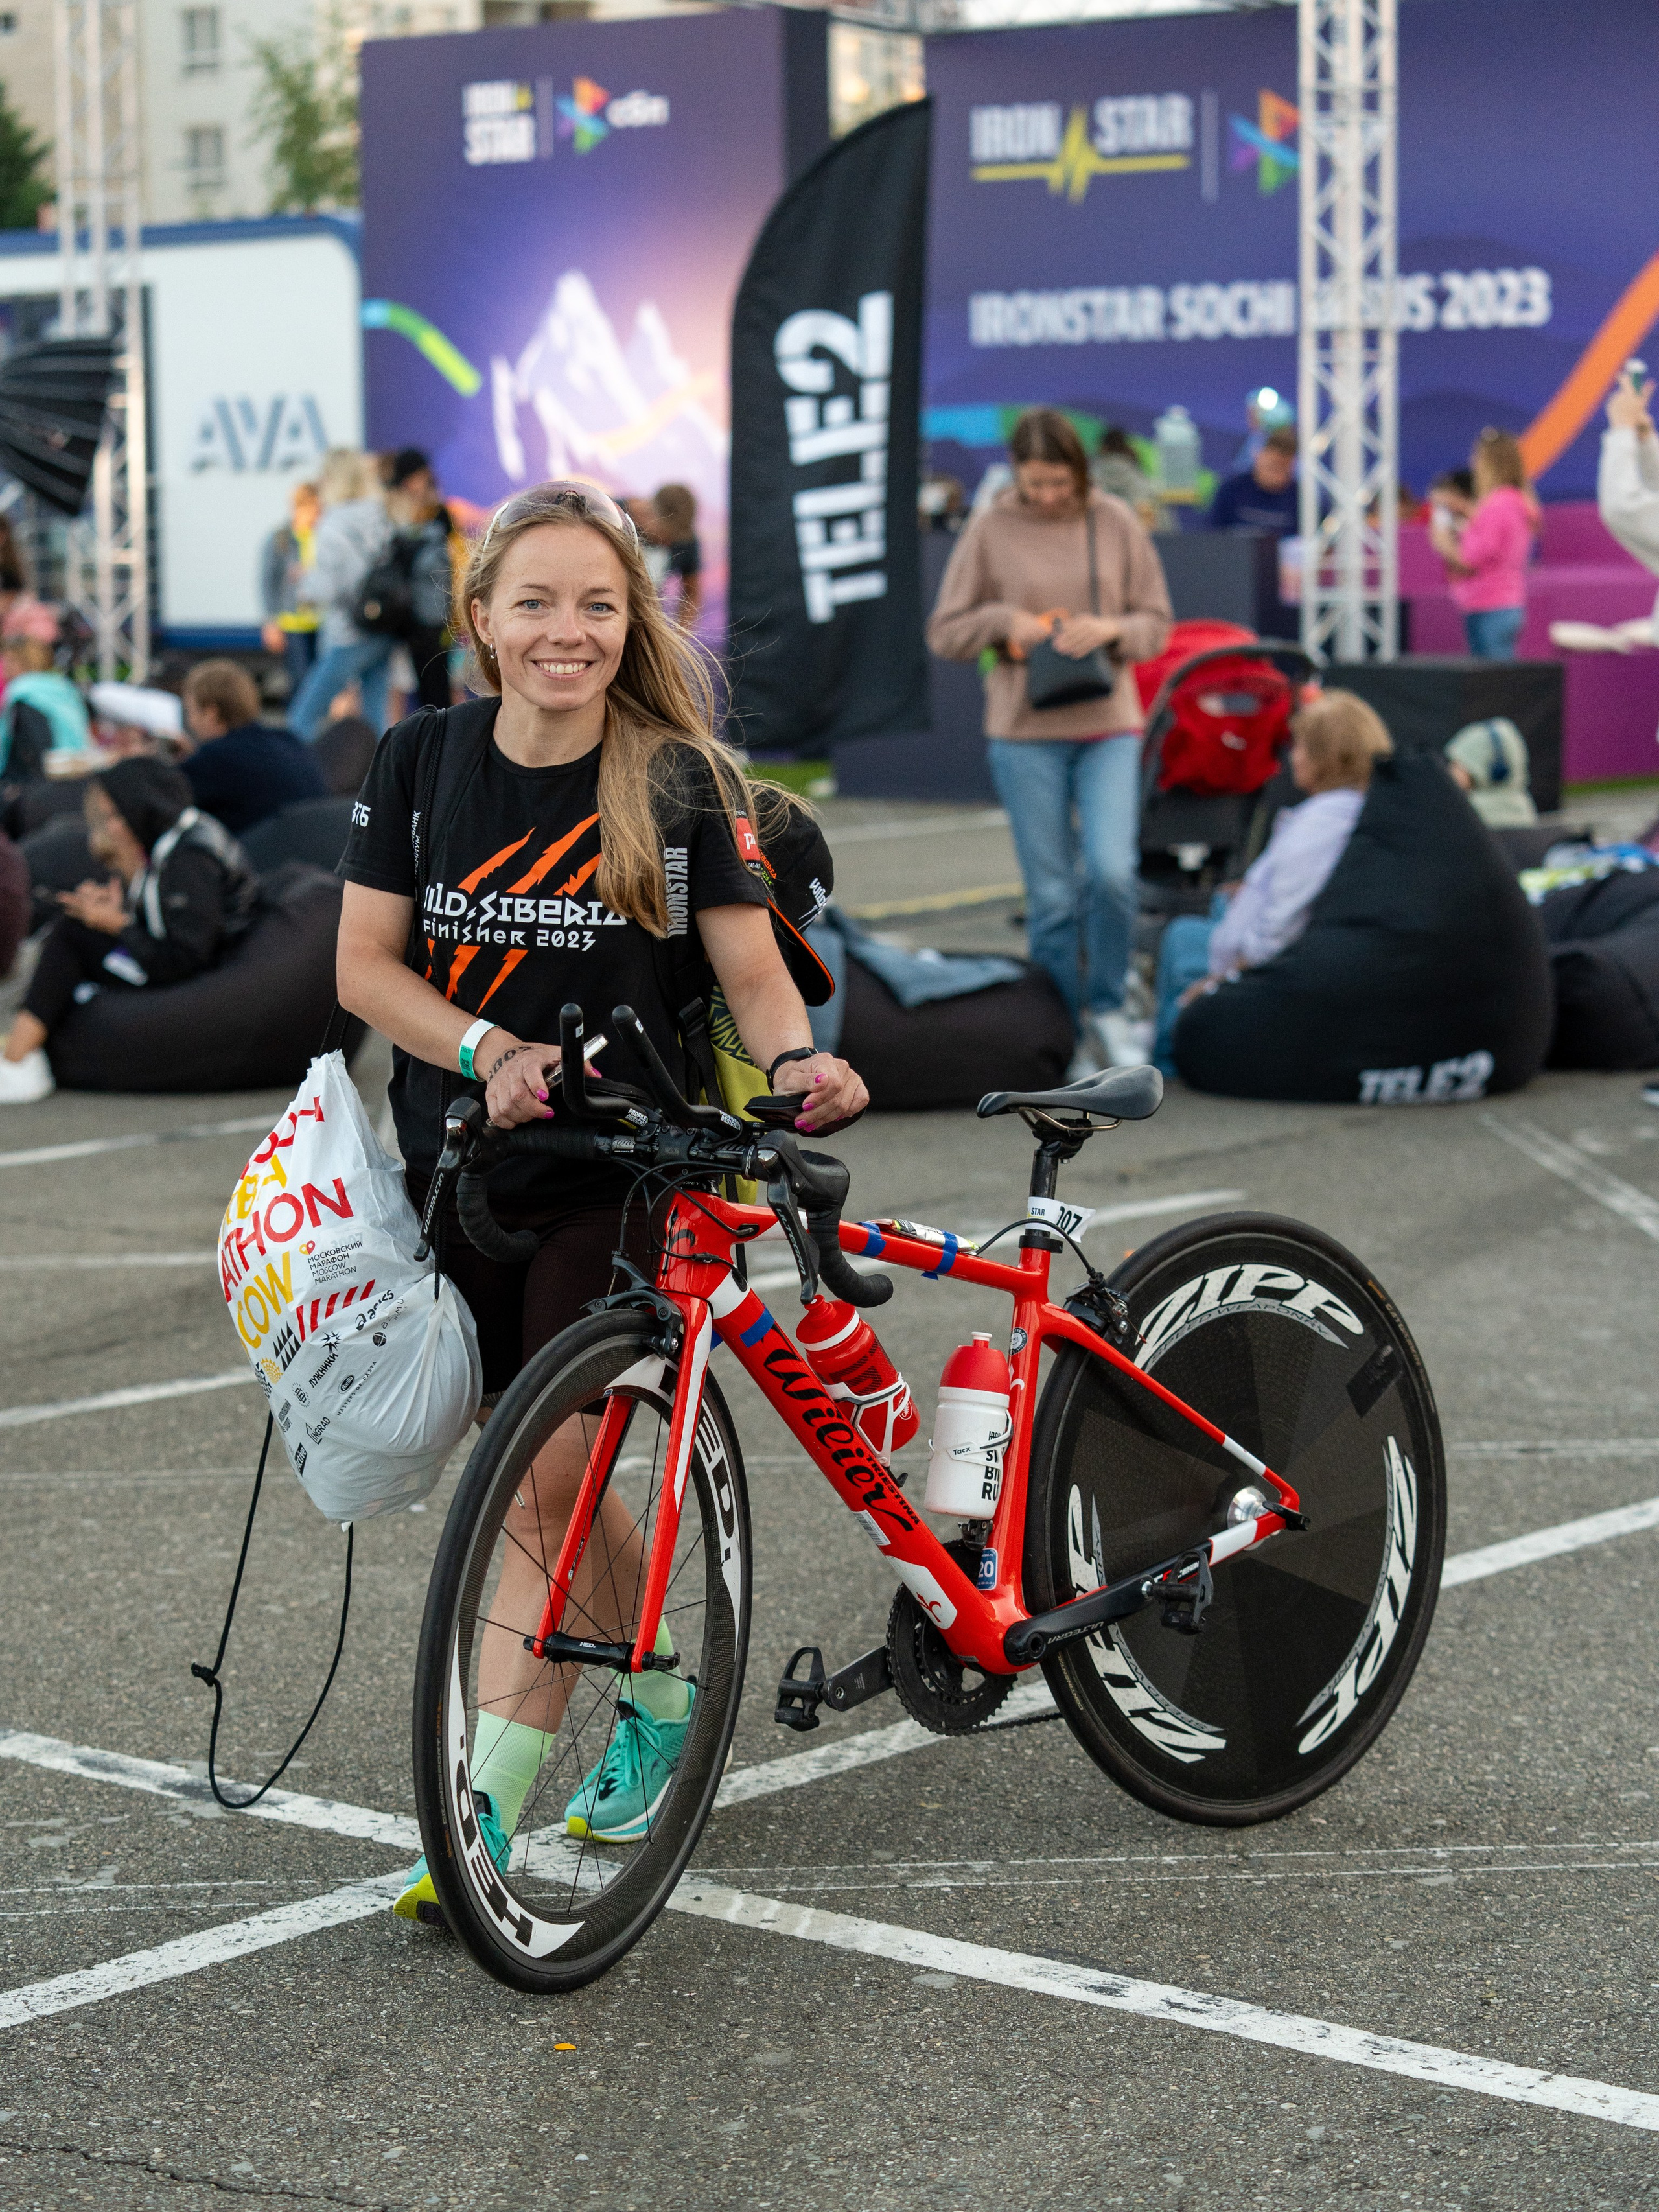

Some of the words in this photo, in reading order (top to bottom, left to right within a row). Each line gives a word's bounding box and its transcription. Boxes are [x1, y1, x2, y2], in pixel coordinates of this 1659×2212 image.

[1095, 93, 1194, 154] STAR
[969, 286, 1166, 347] IRONSTAR
[1168, 279, 1294, 342] SOCHI
[1439, 266, 1553, 331] 2023
[774, 290, 894, 623] TELE2
[664, 847, 688, 938] IRONSTAR
[537, 929, 596, 951] 2023
[628, 1108, 647, 1122] PROFILE
[721, 1115, 737, 1129] DESIGN
[424, 1172, 444, 1235] ULTEGRA
[1031, 1207, 1045, 1216] STAR
[307, 1240, 363, 1264] МОСКОВСКИЙ
[310, 1252, 350, 1271] МАРАФОН
[776, 1208, 806, 1275] ULTEGRA
[312, 1261, 346, 1277] MOSCOW
[314, 1266, 357, 1285] MARATHON
[237, 1251, 294, 1349] COW
[1134, 1264, 1364, 1371] ZIPP
[1149, 1310, 1211, 1365] SPEED
[1218, 1303, 1329, 1336] WEAPONRY
[309, 1353, 339, 1388] ЛУЖНИКИ
[336, 1393, 356, 1416] MASTERS
[363, 1362, 377, 1381] PASTA
[342, 1376, 354, 1391] Barilla
[953, 1447, 971, 1456] Tacx
[866, 1455, 920, 1524] TRIESTINA
[1298, 1436, 1417, 1754] ZIPP
[1047, 1621, 1104, 1645] ULTEGRA
